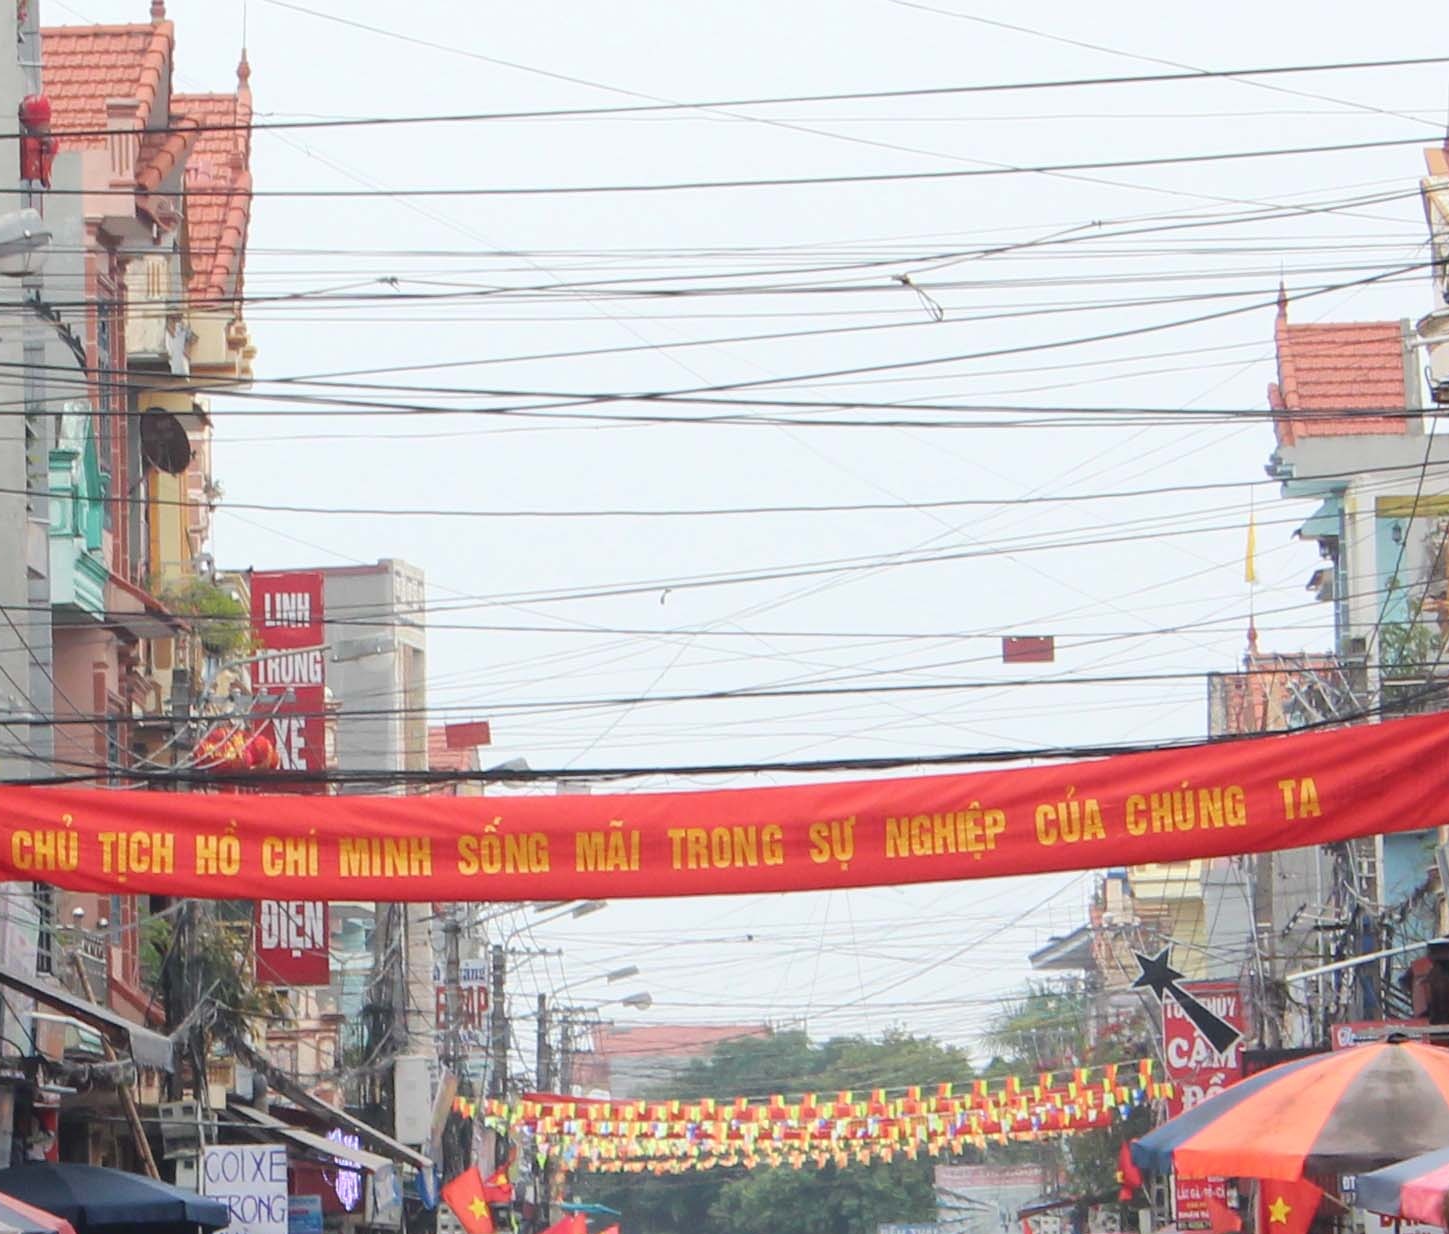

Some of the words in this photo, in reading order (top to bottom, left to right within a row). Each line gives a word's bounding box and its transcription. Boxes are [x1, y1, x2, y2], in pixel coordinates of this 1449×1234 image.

[264, 593, 310, 628] LINH
[254, 648, 323, 685] TRUNG
[274, 719, 306, 770] XE
[11, 815, 78, 872] CHỦ
[98, 832, 173, 883] TỊCH
[195, 819, 241, 876] HỒ
[262, 828, 318, 876] CHÍ
[339, 836, 432, 876] MINH
[457, 815, 549, 874] SỐNG
[575, 826, 641, 874] MÃI
[669, 825, 783, 869] TRONG
[809, 817, 855, 872] SỰ
[886, 802, 1005, 860] NGHIỆP
[1035, 786, 1106, 847] CỦA
[1125, 782, 1246, 837] CHÚNG
[1279, 778, 1323, 820] TA
[261, 899, 324, 957] ĐIỆN
[204, 1150, 244, 1183] COI
[250, 1150, 287, 1183] XE
